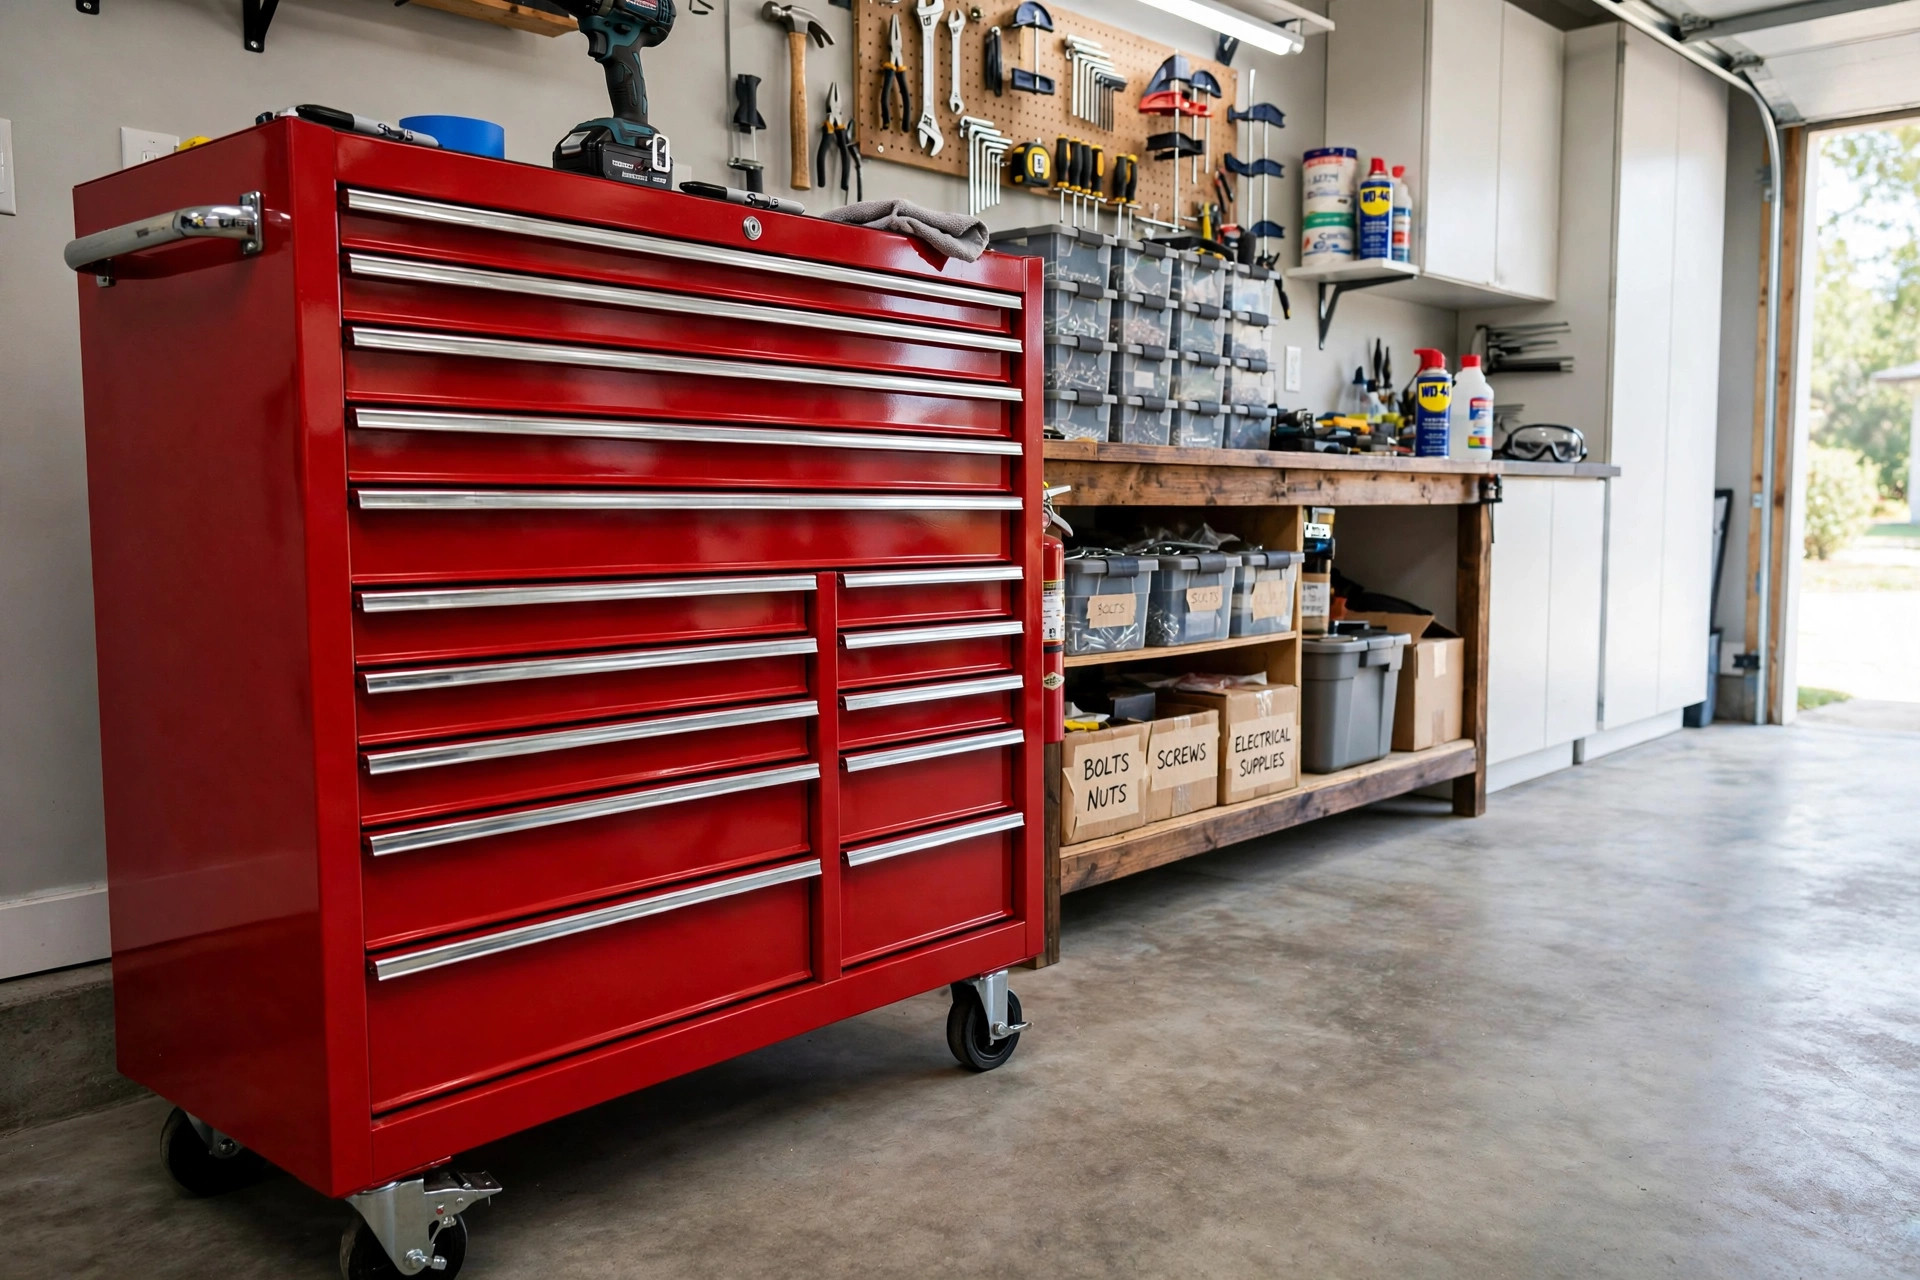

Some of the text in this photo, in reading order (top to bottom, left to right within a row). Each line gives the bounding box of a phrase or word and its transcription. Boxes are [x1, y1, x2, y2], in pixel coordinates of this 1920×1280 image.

[1235, 727, 1291, 753] ELECTRICAL
[1084, 753, 1130, 780] BOLTS
[1157, 742, 1207, 769] SCREWS
[1239, 751, 1285, 777] SUPPLIES
[1087, 783, 1127, 811] NUTS
